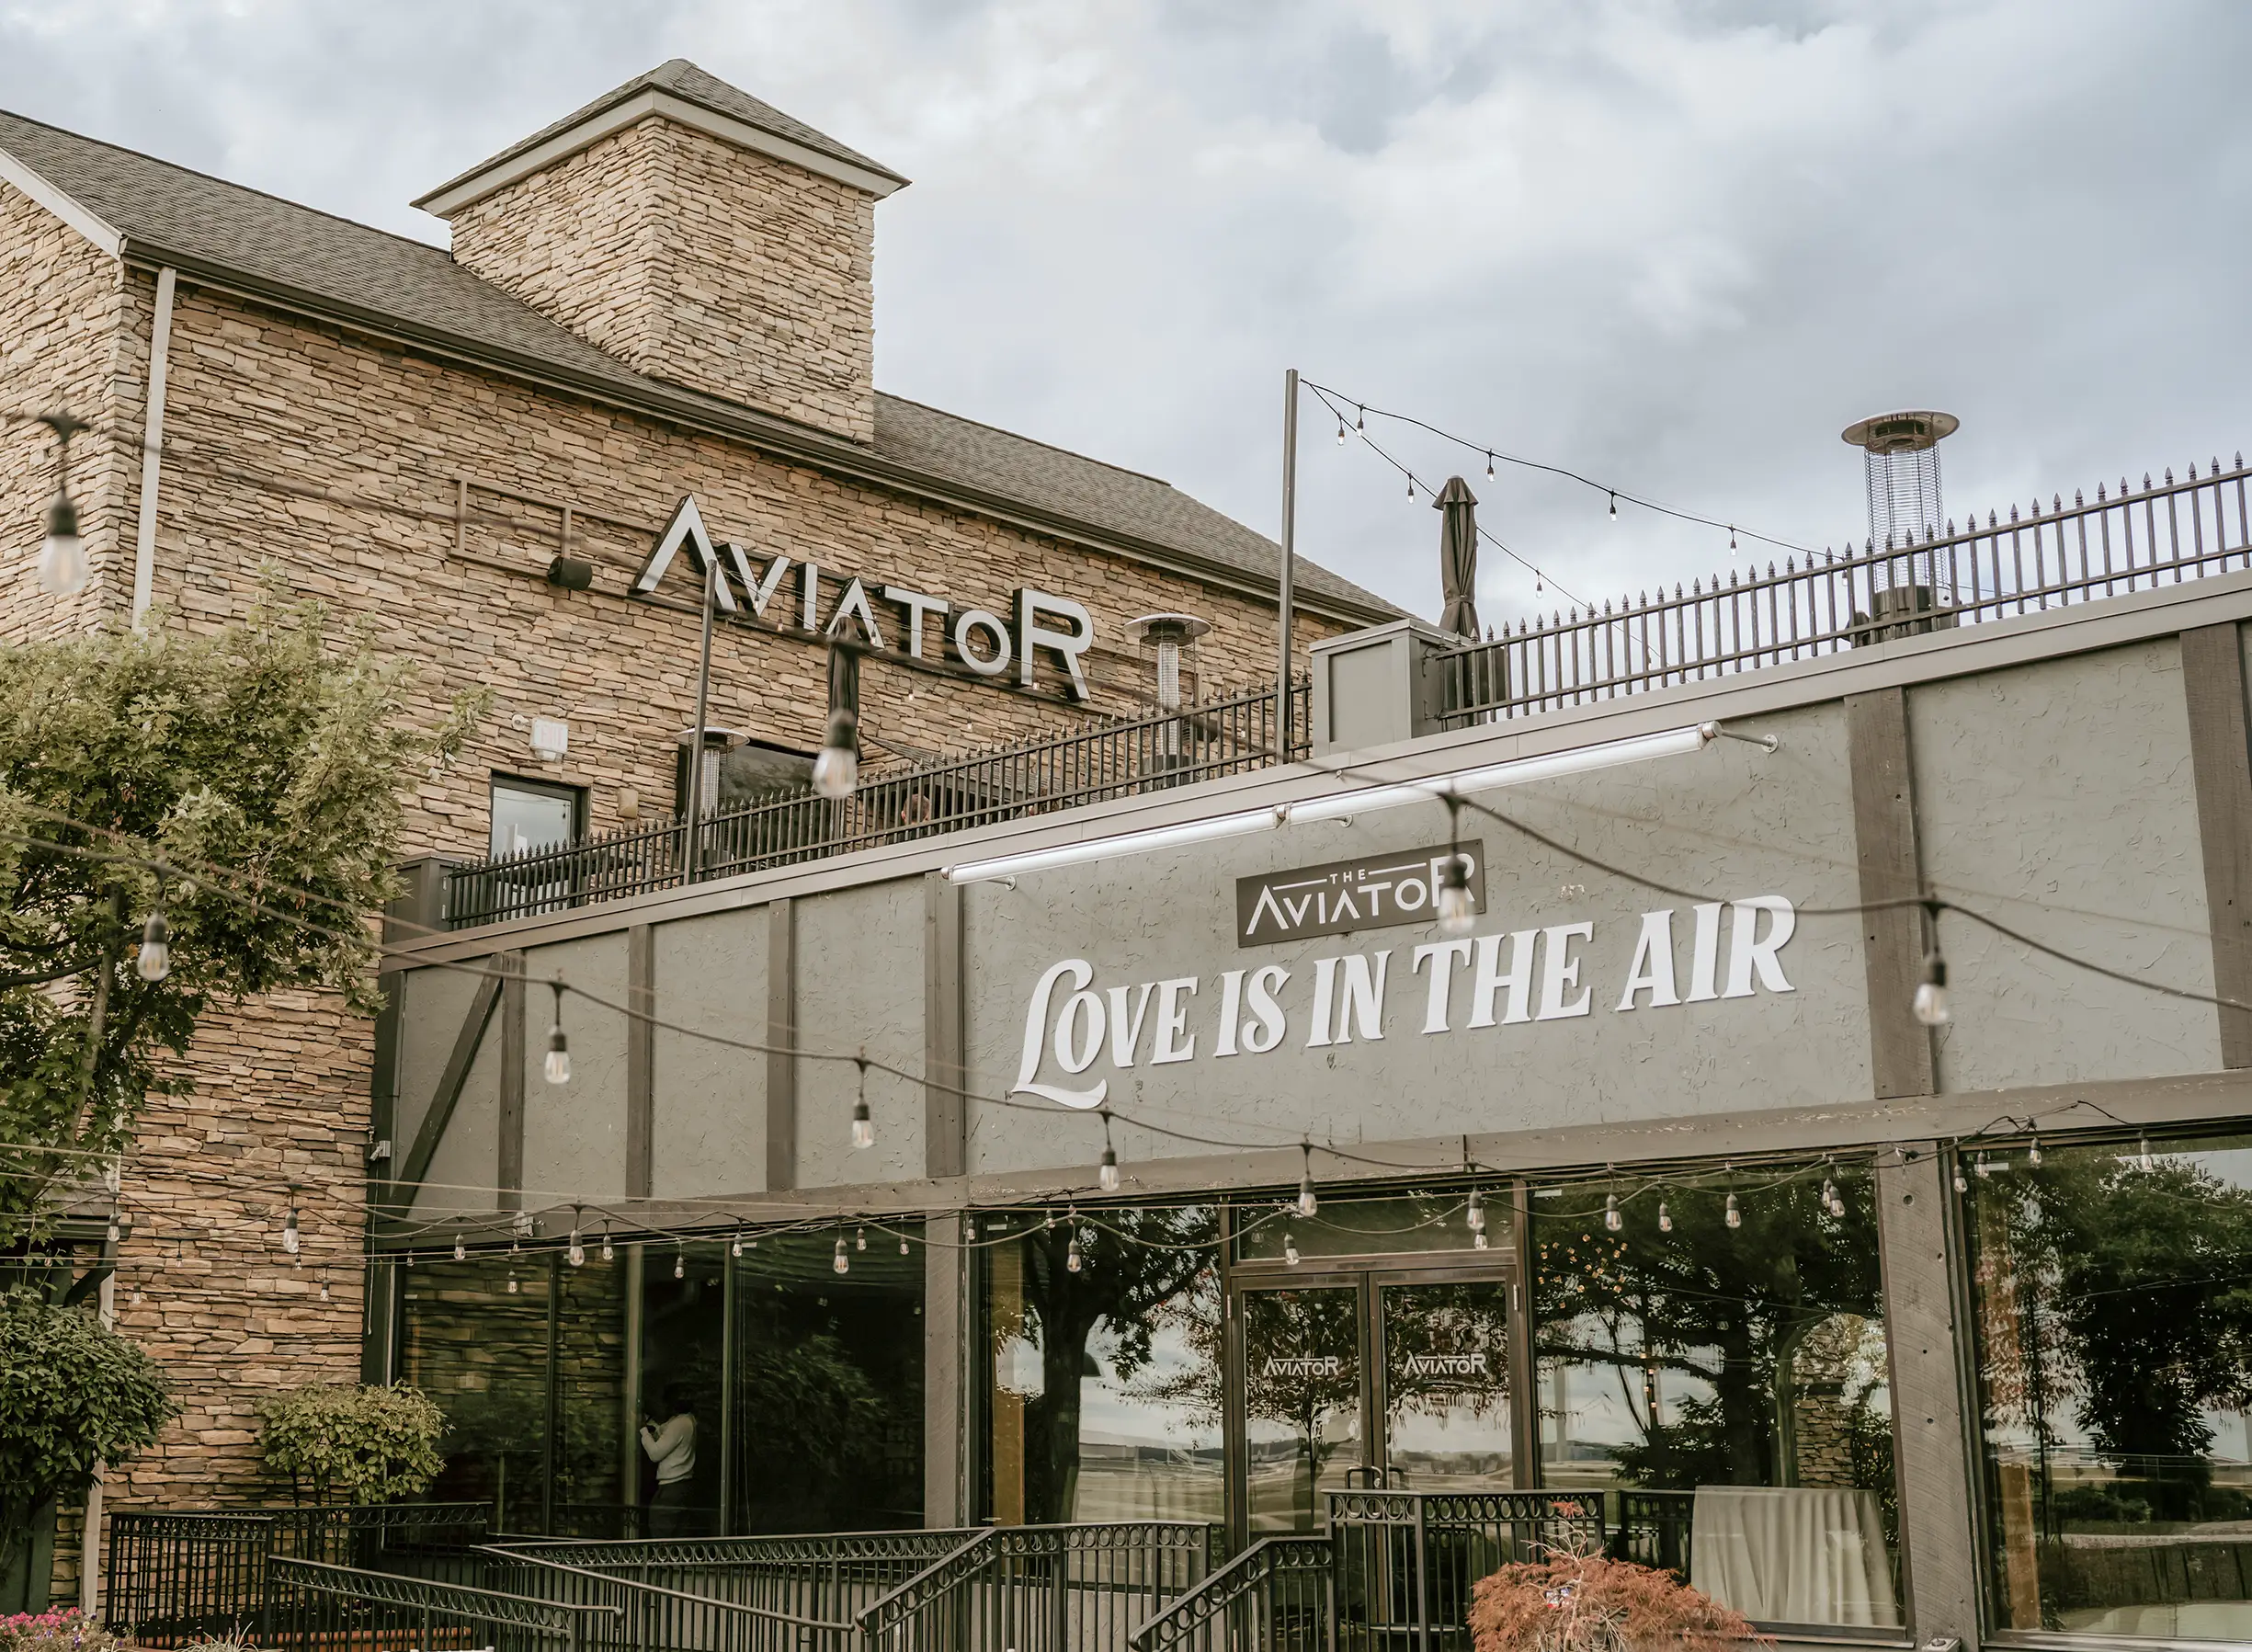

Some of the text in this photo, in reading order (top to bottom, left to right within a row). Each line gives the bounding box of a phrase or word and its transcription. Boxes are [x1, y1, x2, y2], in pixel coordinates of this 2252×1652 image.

[631, 493, 1095, 701] AVIATOR
[1245, 853, 1475, 935] AVIATOR
[1329, 869, 1366, 884] THE
[1011, 894, 1796, 1109] LOVE IS IN THE AIR
[1263, 1355, 1339, 1376] AVIATOR
[1404, 1352, 1486, 1375] AVIATOR
